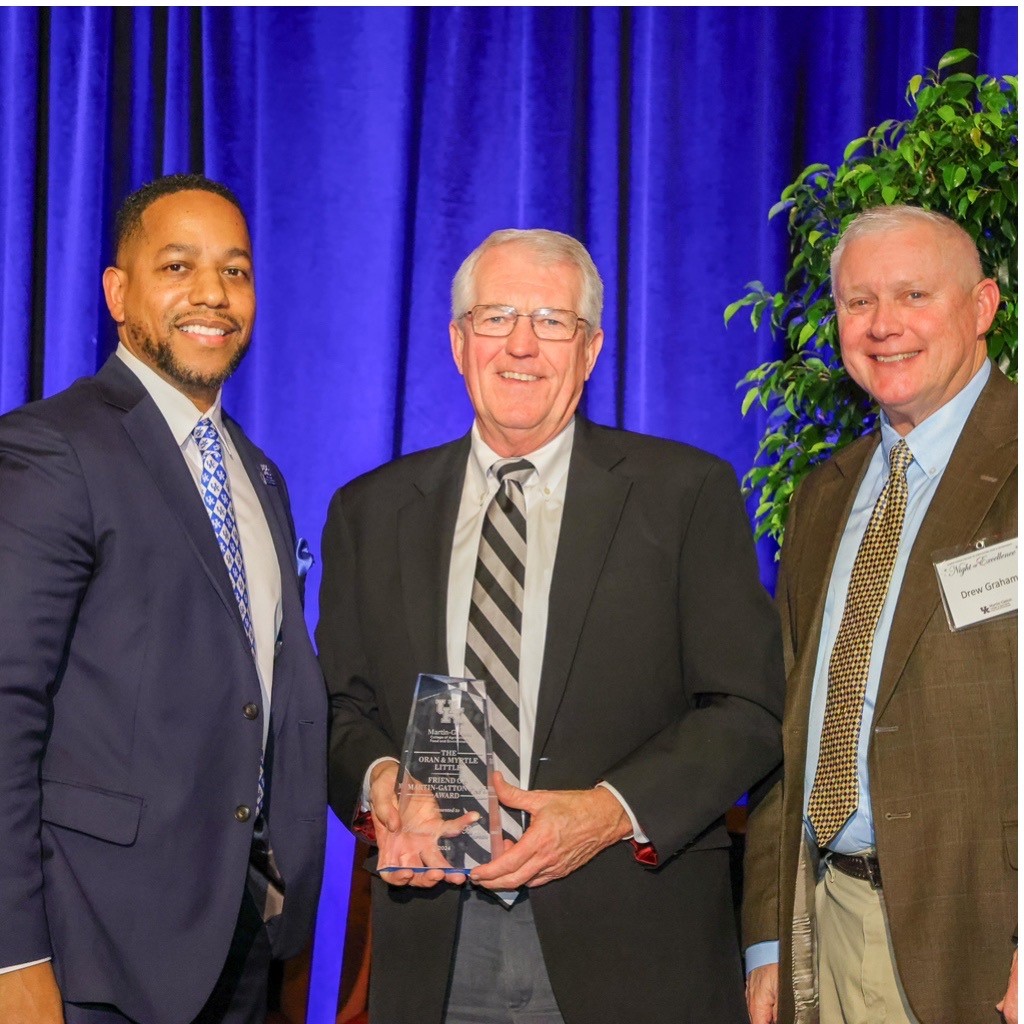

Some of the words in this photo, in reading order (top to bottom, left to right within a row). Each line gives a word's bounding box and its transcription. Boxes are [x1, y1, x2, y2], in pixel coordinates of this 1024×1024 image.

[961, 586, 983, 599] Drew
[985, 575, 1018, 591] Graham
[418, 756, 440, 764] ORAN
[428, 776, 456, 784] FRIEND
[434, 792, 460, 800] AWARD
